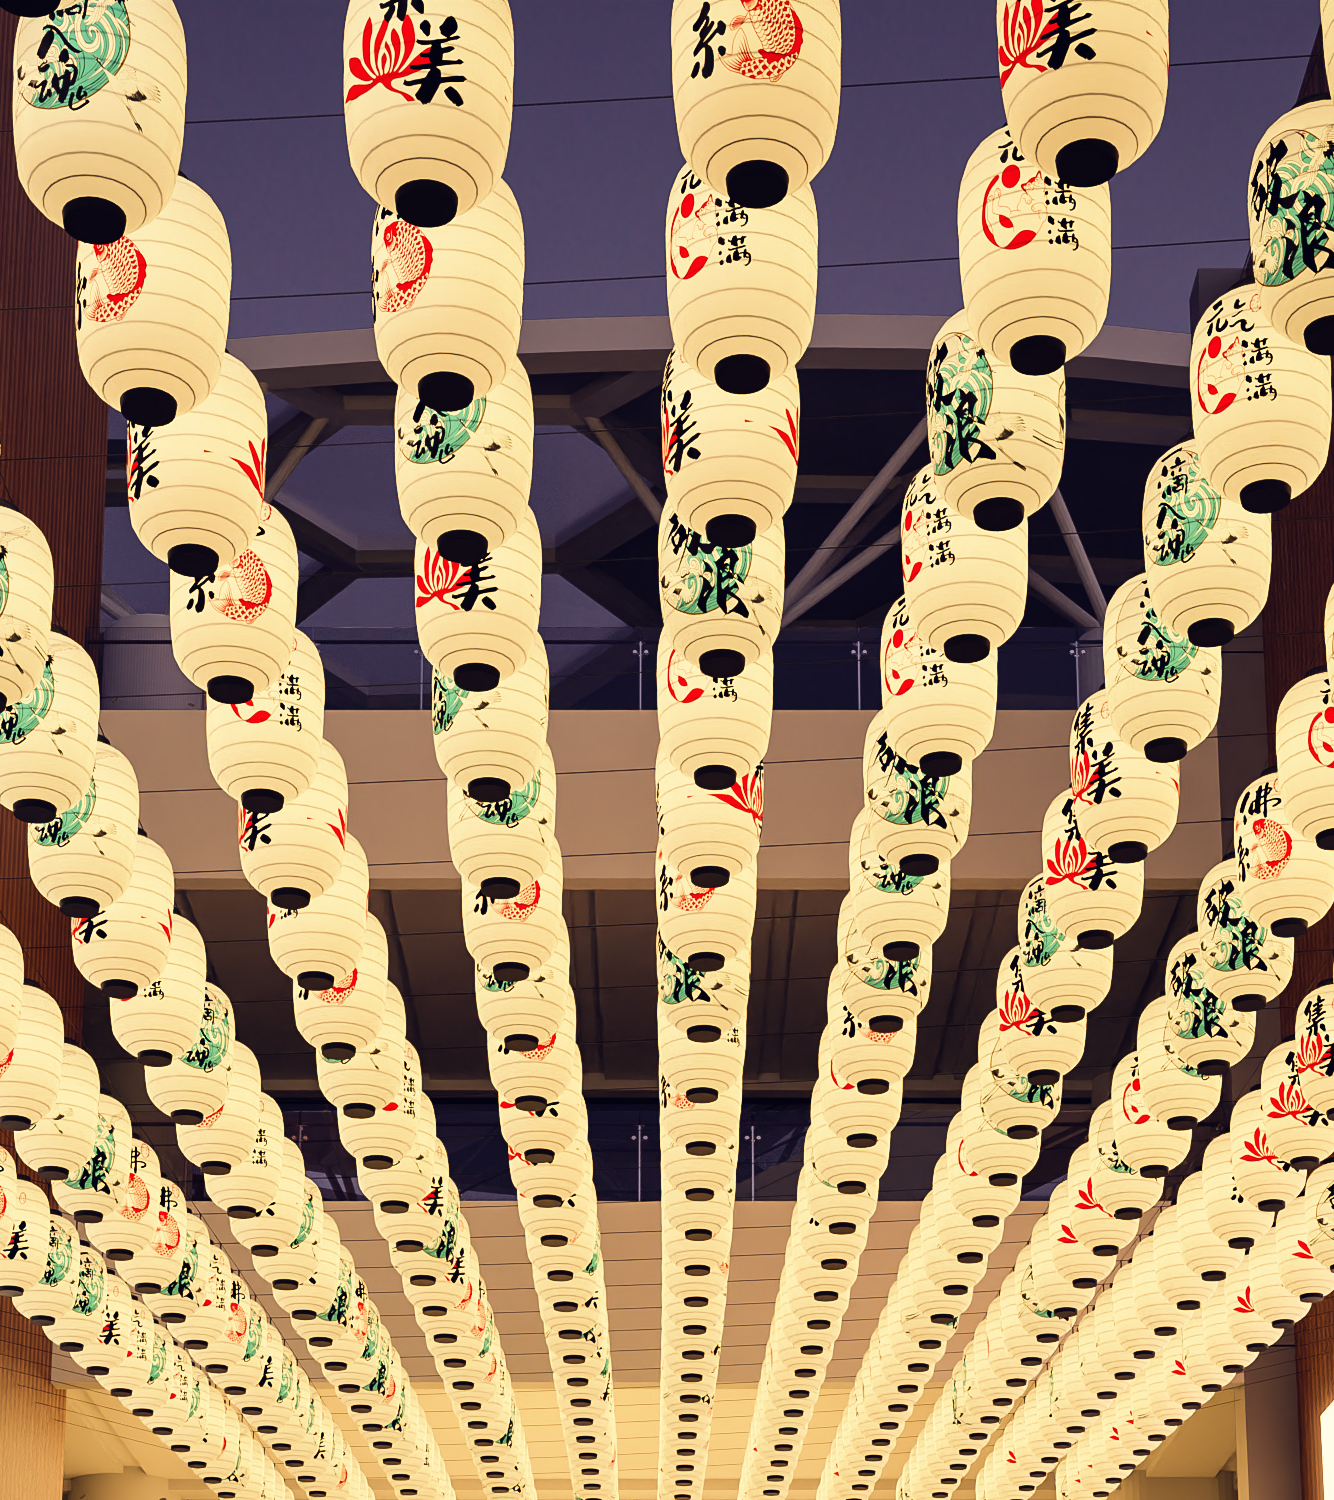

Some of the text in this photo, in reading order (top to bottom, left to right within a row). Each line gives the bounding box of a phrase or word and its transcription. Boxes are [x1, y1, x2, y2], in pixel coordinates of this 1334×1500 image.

[1243, 338, 1277, 401] 满满
[927, 509, 956, 567] 满满
[1072, 702, 1122, 805] 集美
[1205, 880, 1267, 971] 破浪
[1167, 952, 1229, 1039] 破浪
